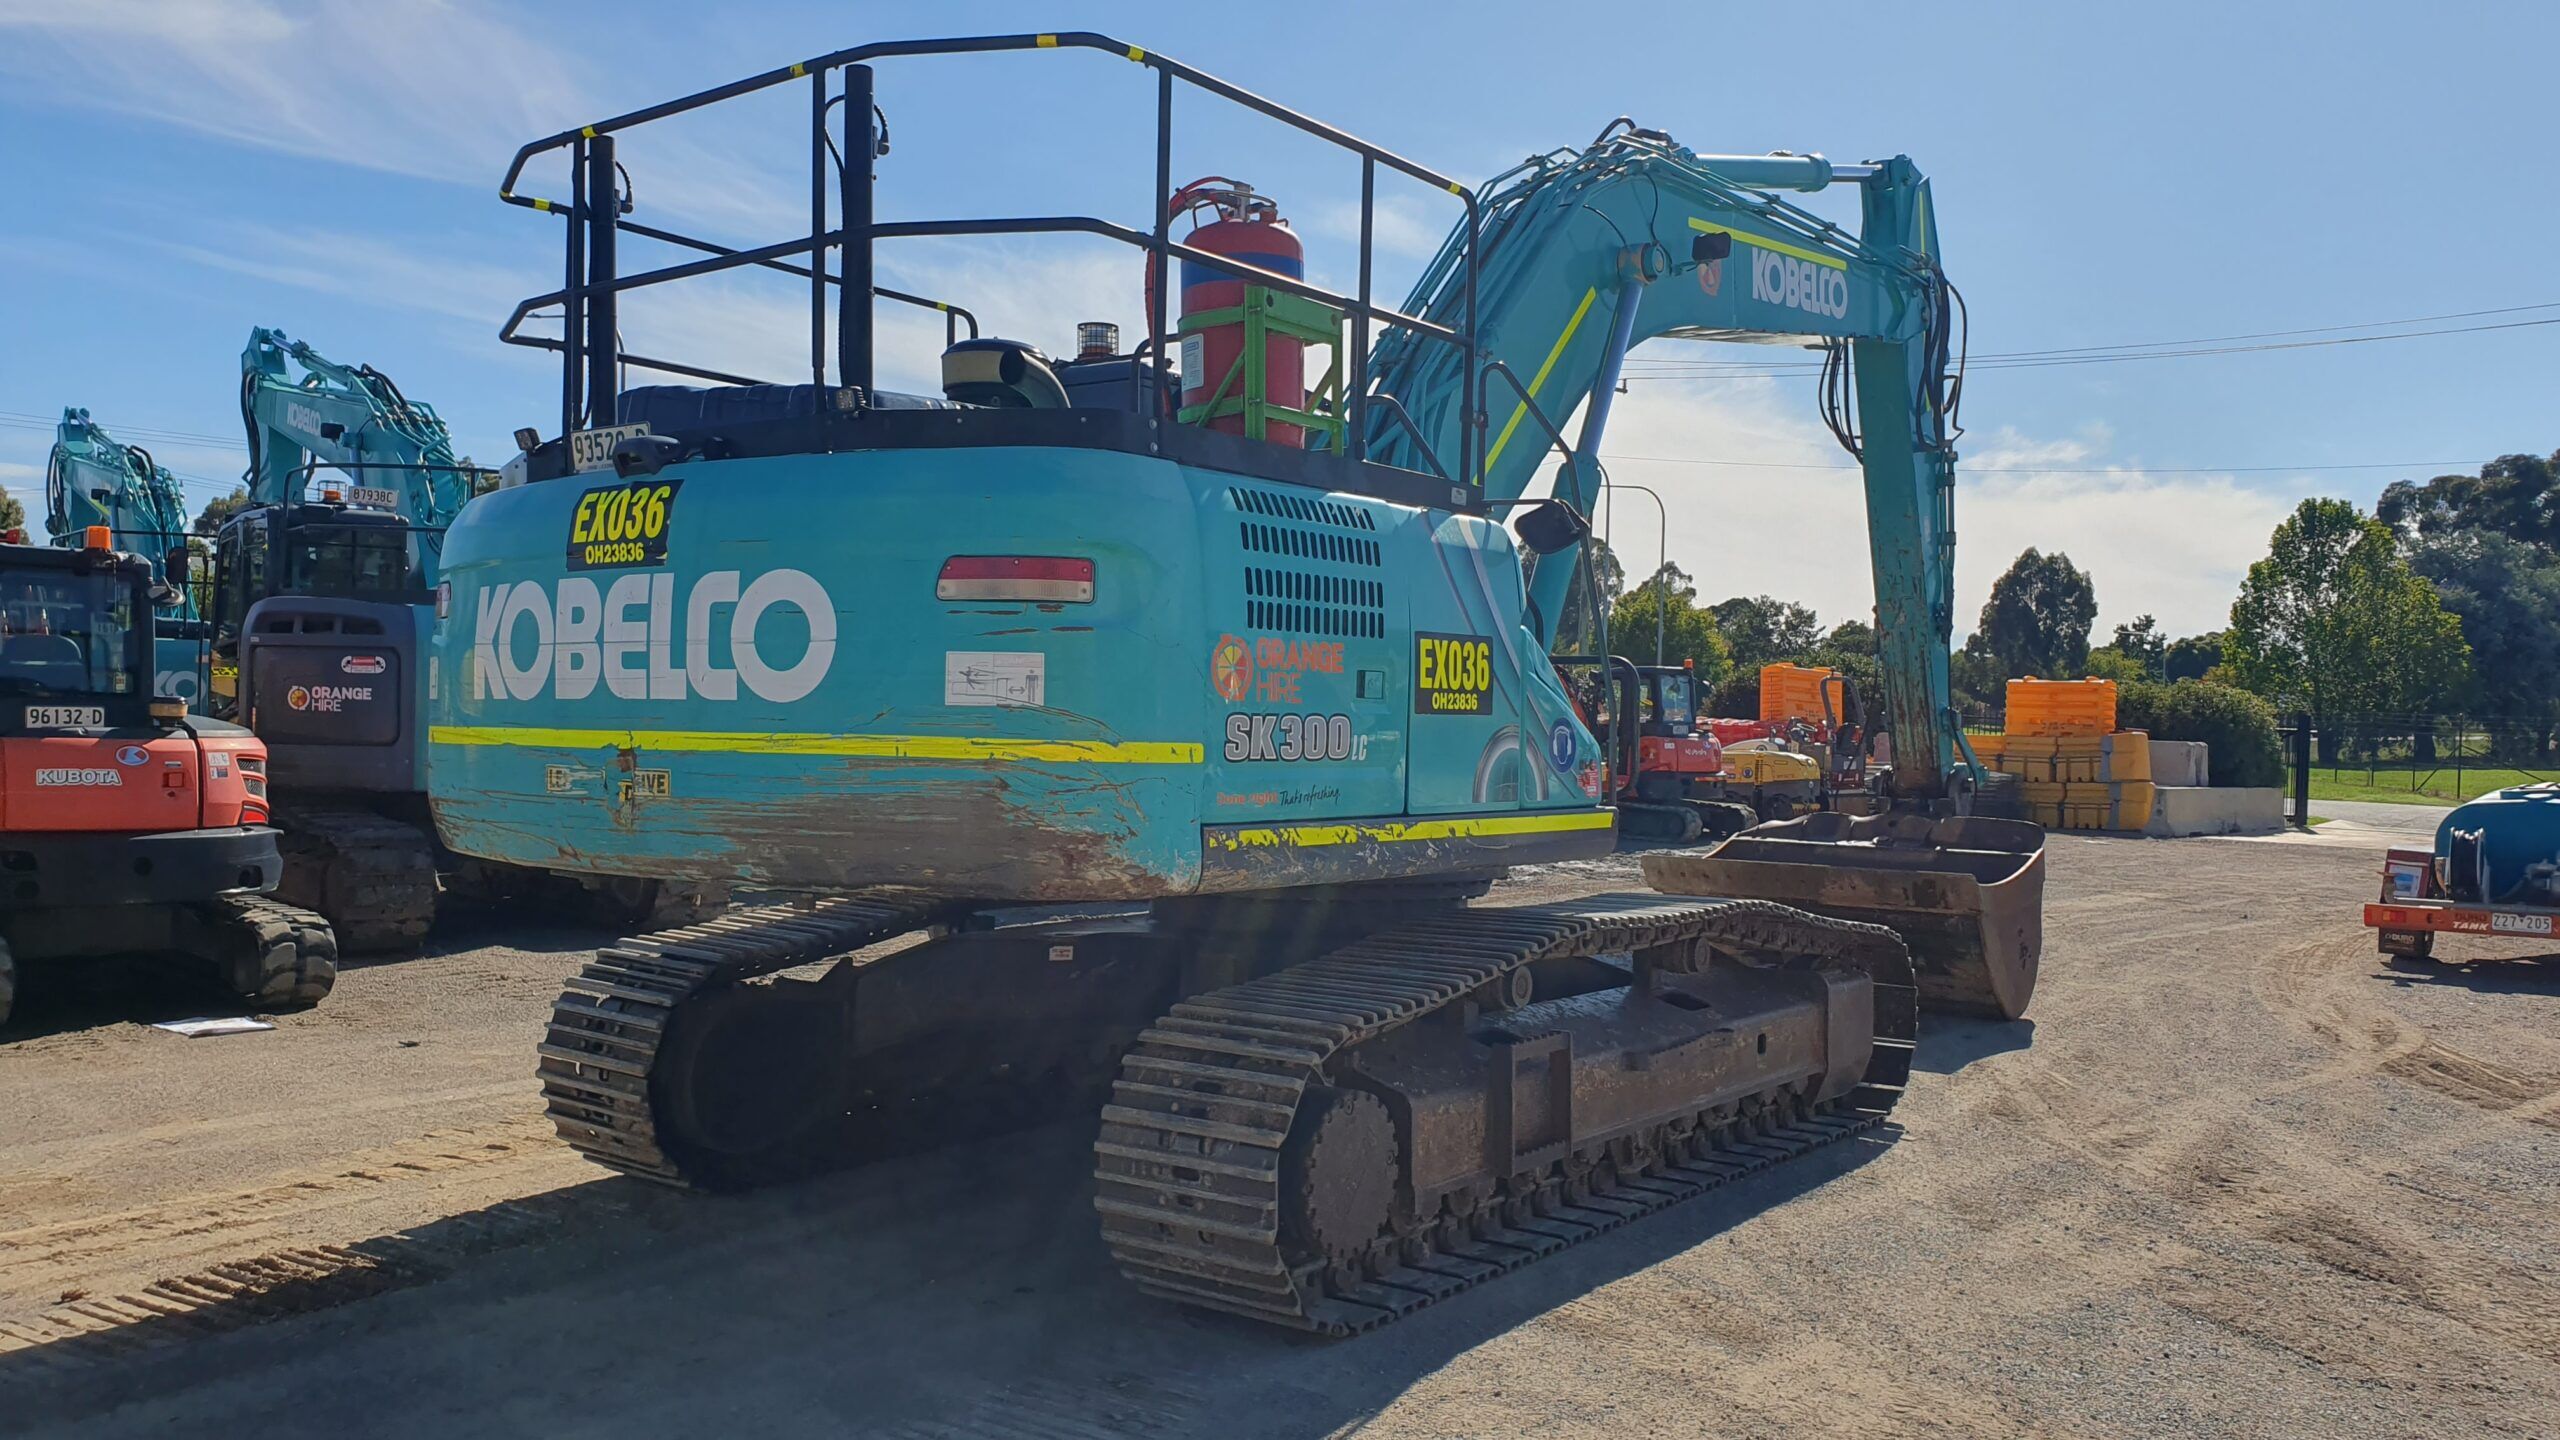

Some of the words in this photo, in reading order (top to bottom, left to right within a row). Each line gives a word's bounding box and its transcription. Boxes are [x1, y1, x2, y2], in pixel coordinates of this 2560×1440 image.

[1752, 247, 1848, 319] KOBELCO
[353, 488, 393, 503] 87938C
[573, 485, 671, 543] EX036
[474, 569, 837, 703] KOBELCO
[1256, 638, 1344, 674] ORANGE
[1420, 638, 1490, 691] EX036
[311, 686, 372, 700] ORANGE
[1256, 672, 1303, 703] HIRE
[311, 699, 342, 712] HIRE
[1224, 712, 1352, 763] SK300
[1351, 735, 1367, 761] LC
[36, 769, 122, 785] KUBOTA
[2452, 921, 2490, 931] TANK
